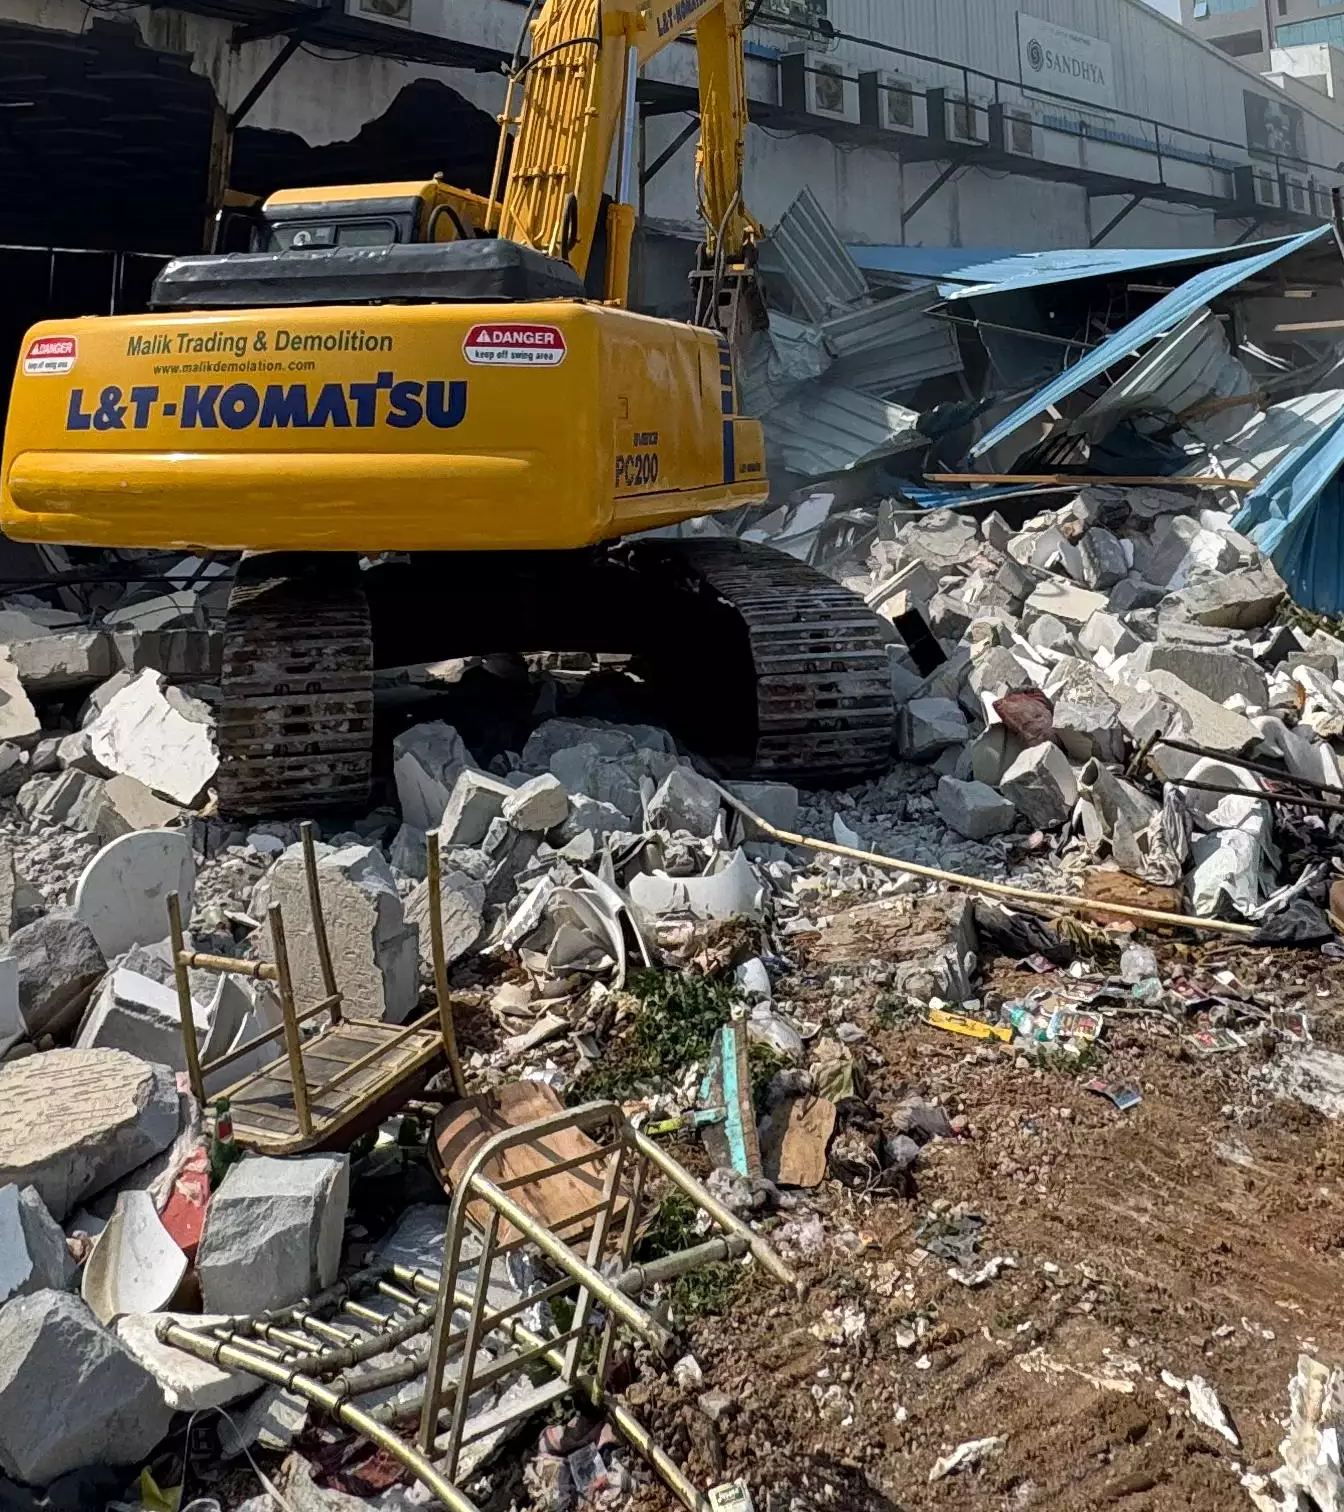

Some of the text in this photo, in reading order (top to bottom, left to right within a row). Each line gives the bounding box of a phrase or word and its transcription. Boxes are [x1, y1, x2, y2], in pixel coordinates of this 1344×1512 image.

[1045, 50, 1105, 85] SANDHYA
[39, 341, 72, 354] DANGER
[127, 329, 393, 357] Malik Trading & Demolition
[493, 331, 555, 345] DANGER
[616, 453, 658, 488] PC200
